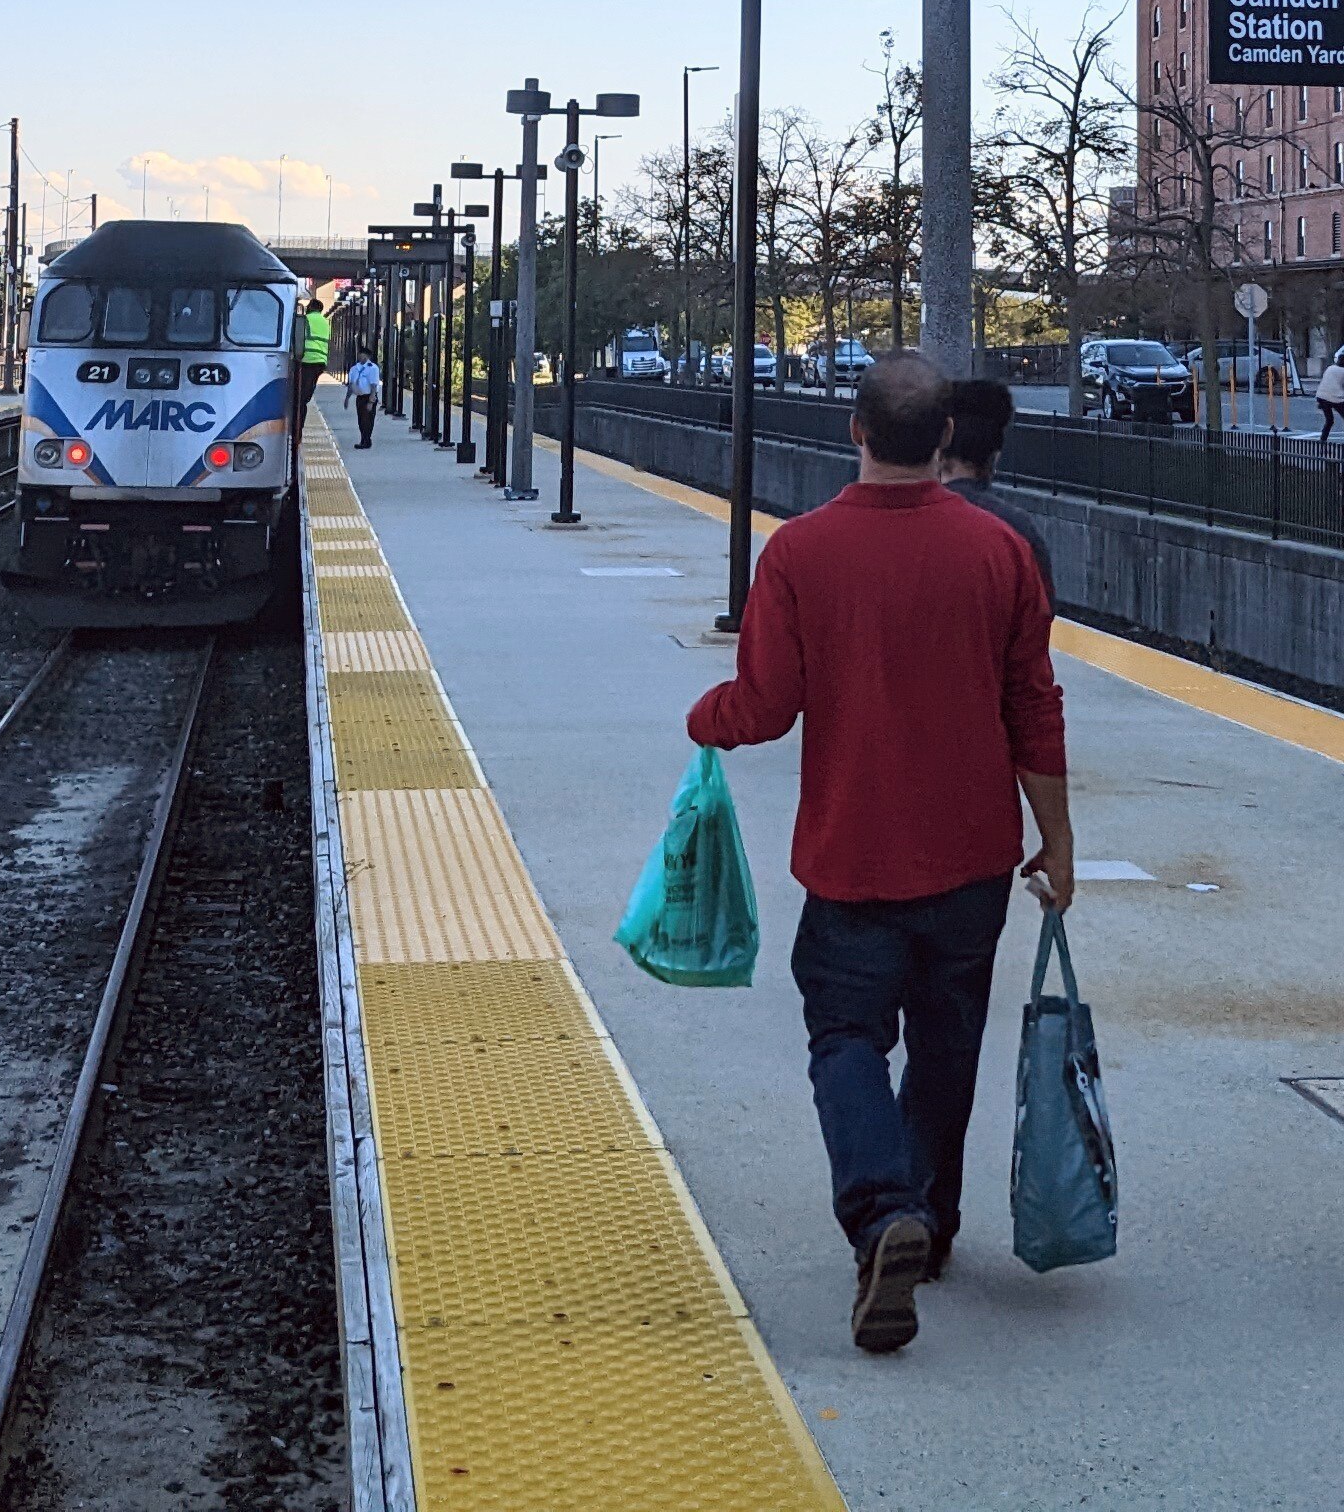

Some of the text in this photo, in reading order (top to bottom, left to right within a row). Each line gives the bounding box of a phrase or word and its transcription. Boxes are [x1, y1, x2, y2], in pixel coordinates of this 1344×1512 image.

[1228, 12, 1323, 40] Station
[1228, 43, 1302, 63] Camden
[87, 365, 110, 380] 21
[199, 368, 221, 382] 21
[84, 399, 216, 433] MARC
